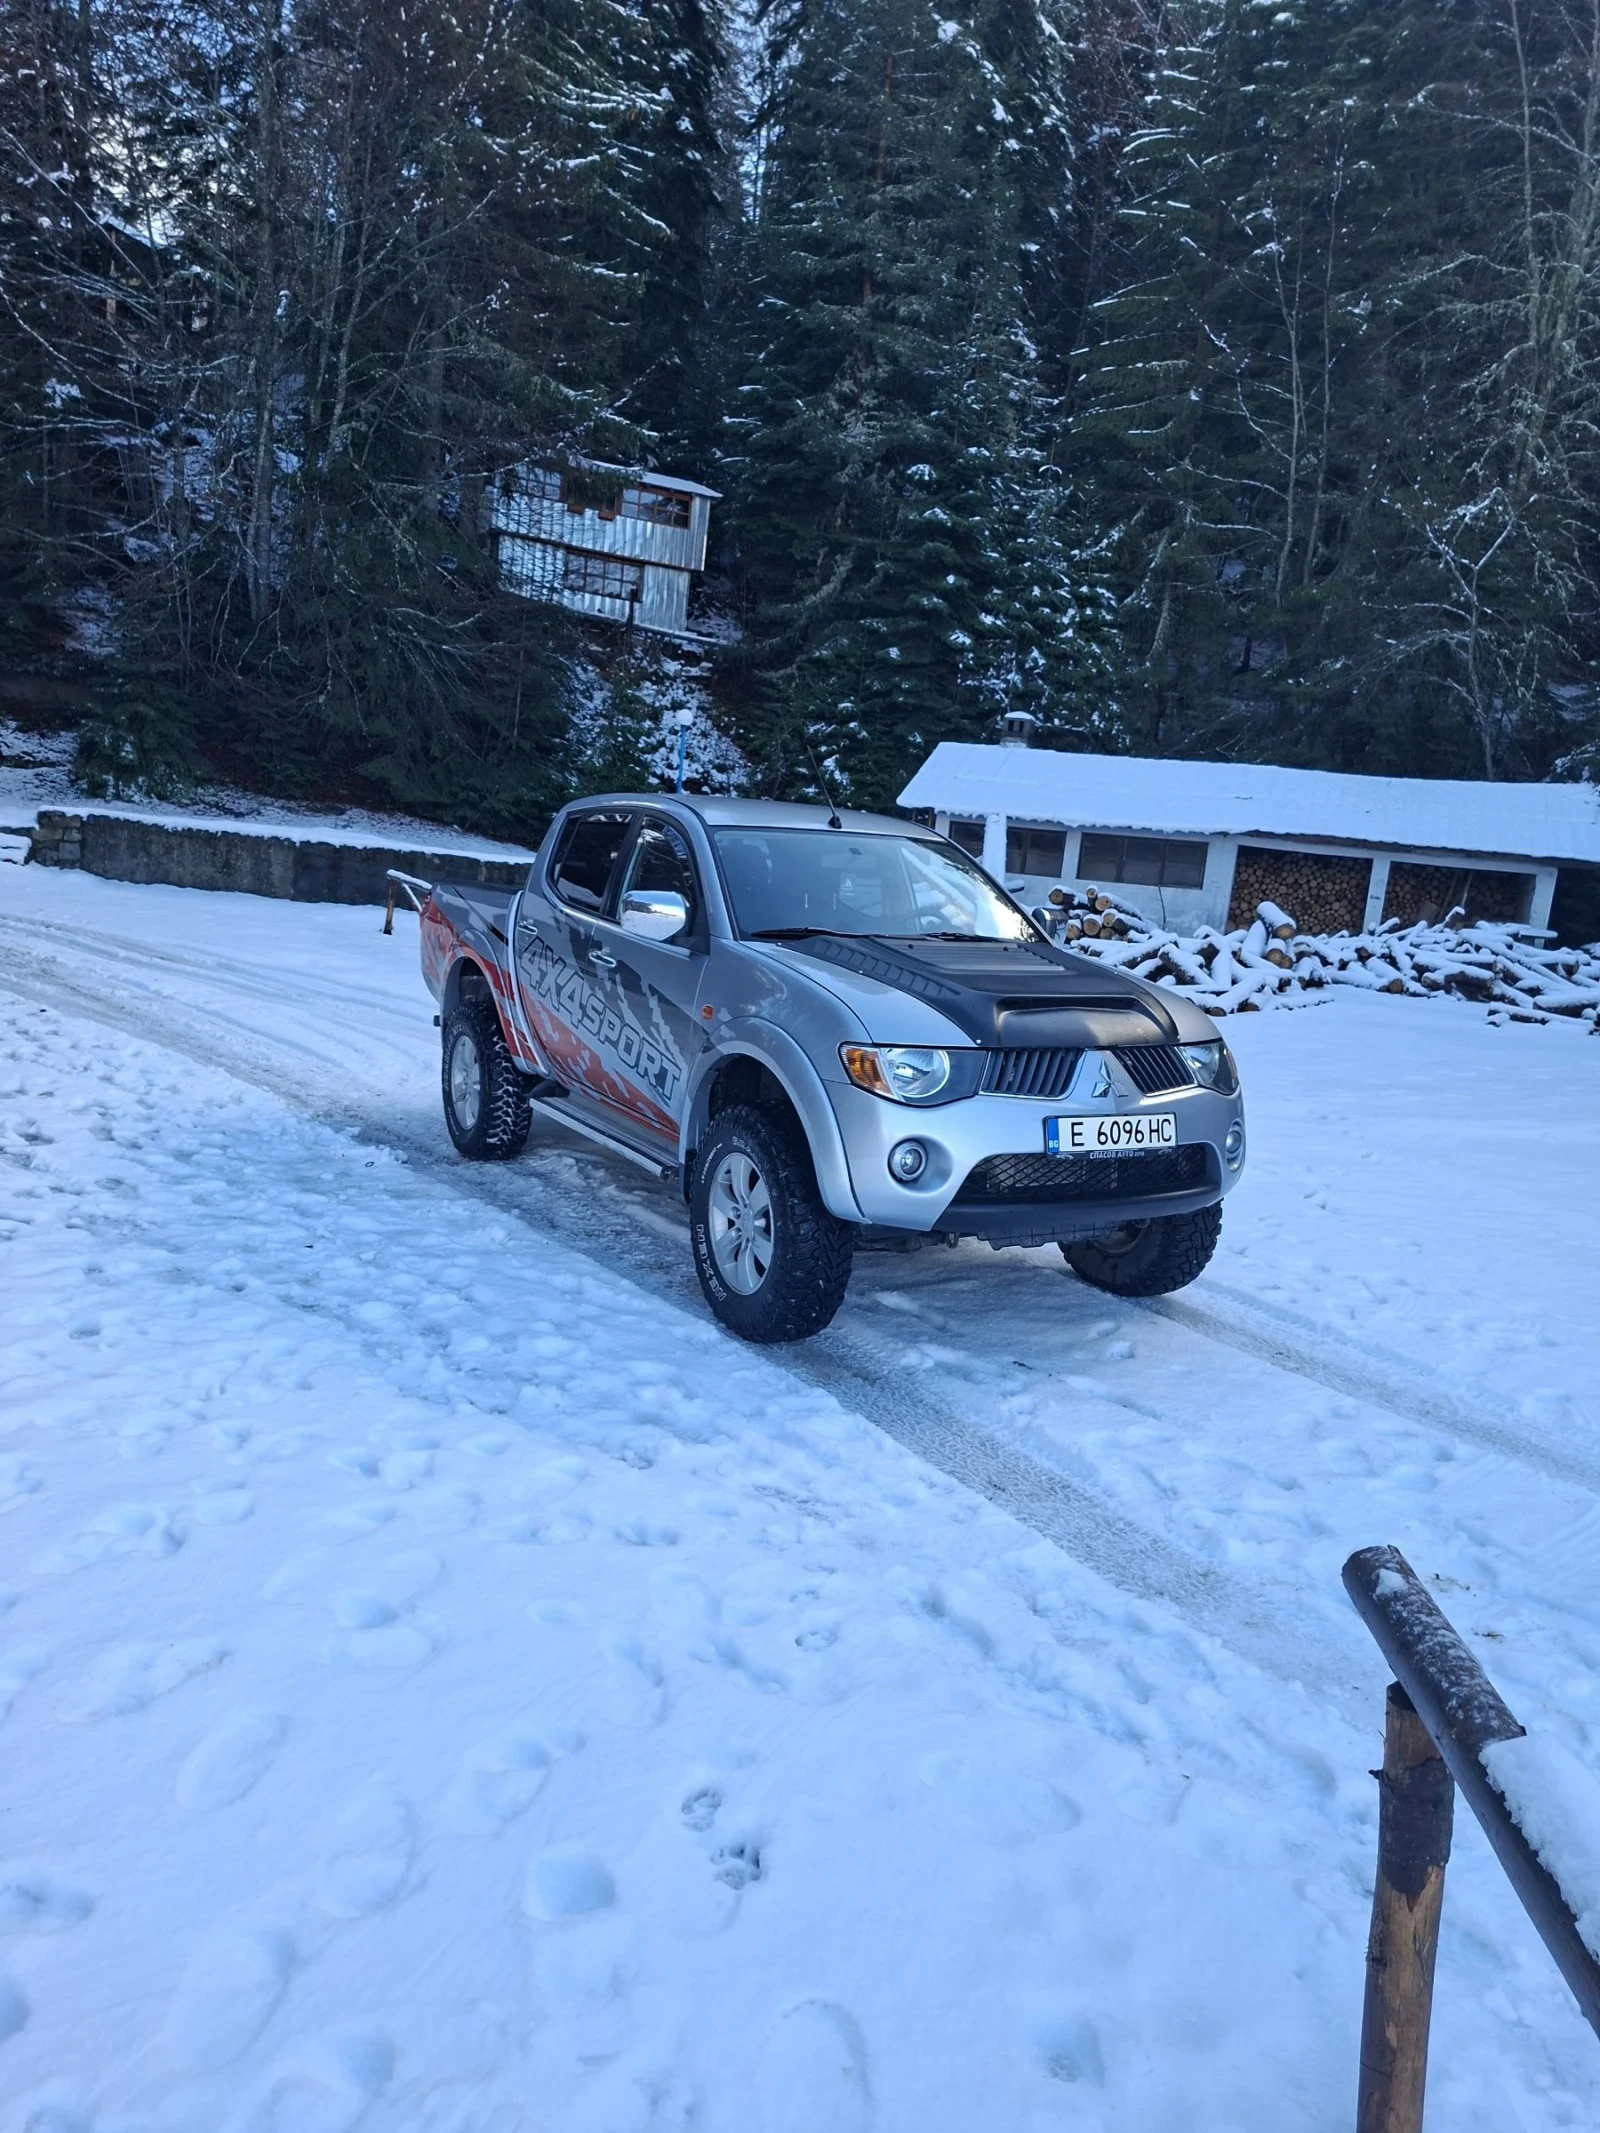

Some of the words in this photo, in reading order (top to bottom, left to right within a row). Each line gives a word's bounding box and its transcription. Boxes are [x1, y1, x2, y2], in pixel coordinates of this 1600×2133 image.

[1071, 1122, 1084, 1147] E
[1097, 1119, 1145, 1146] 6096
[1149, 1118, 1172, 1143] HC
[1048, 1140, 1059, 1148] BG
